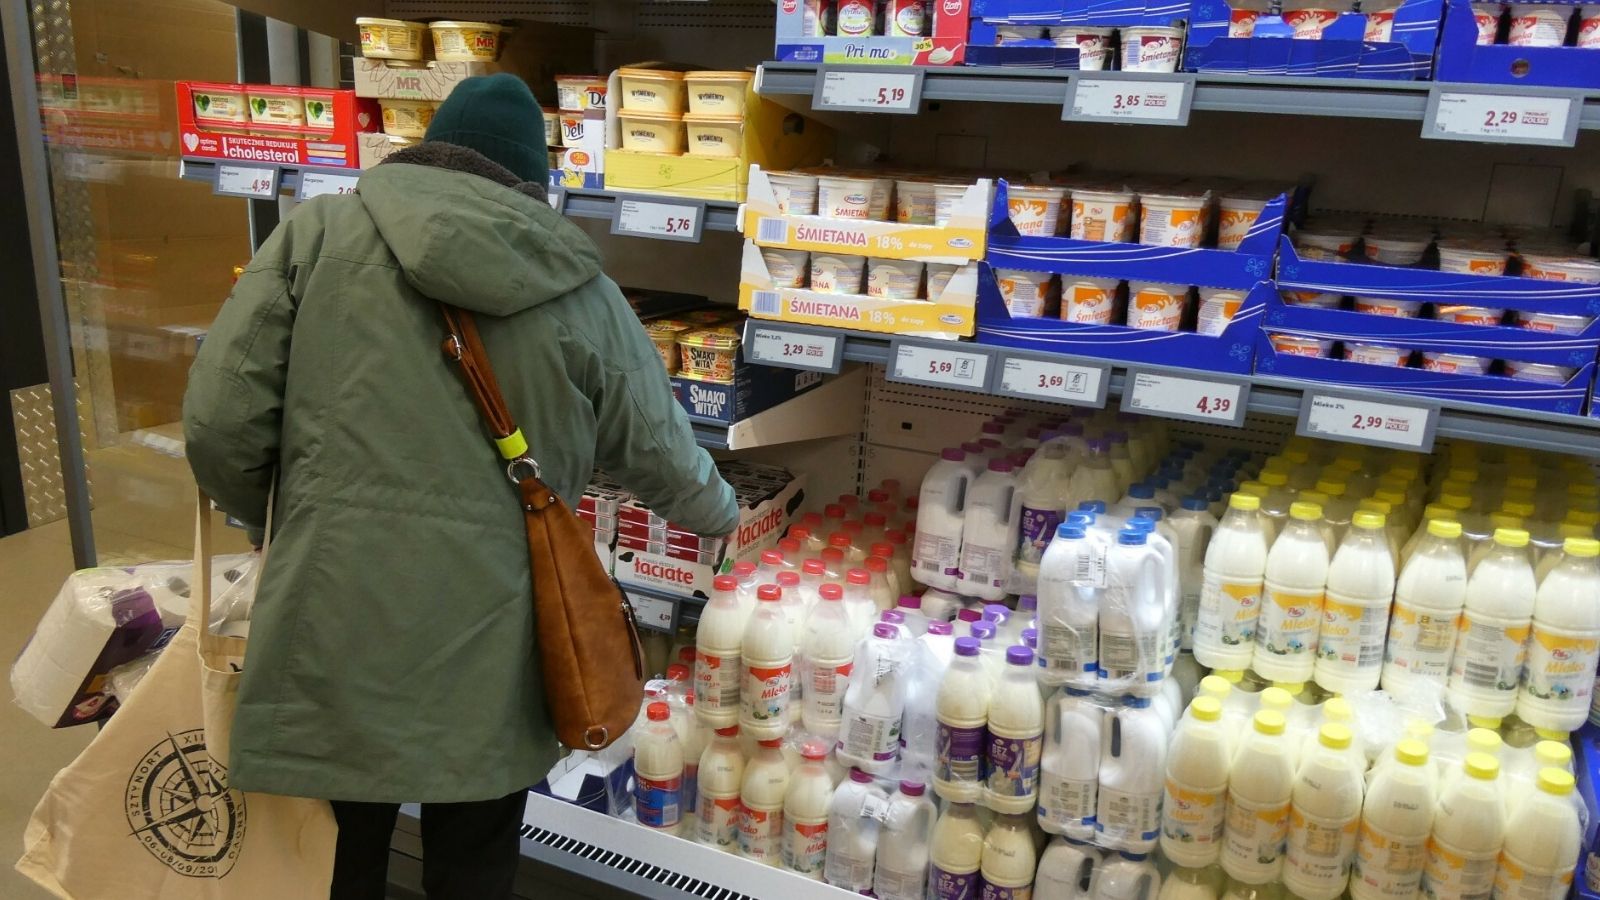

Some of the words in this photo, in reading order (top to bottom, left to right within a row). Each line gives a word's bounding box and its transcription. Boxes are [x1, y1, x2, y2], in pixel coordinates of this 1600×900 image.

[476, 37, 494, 48] MR
[845, 44, 865, 58] Pri
[396, 76, 422, 91] MR
[877, 87, 905, 105] 5.19
[1113, 94, 1140, 109] 3.85
[1484, 110, 1518, 127] 2.29
[229, 137, 265, 146] SKUTECZNIE
[265, 140, 298, 149] REDUKUJE
[231, 146, 299, 163] cholesterol
[666, 217, 691, 233] 5.76
[796, 224, 867, 246] ŚMIETANA
[876, 235, 904, 250] 18%
[790, 297, 860, 320] ŚMIETANA
[868, 310, 896, 325] 18%
[691, 347, 715, 363] SMAKO
[783, 343, 803, 356] 3.29
[695, 360, 711, 369] WITA
[929, 361, 952, 374] 5.69
[1038, 375, 1063, 388] 3.69
[689, 384, 726, 409] SMAKO
[695, 401, 719, 417] WITA
[1196, 396, 1230, 414] 4.39
[1313, 401, 1335, 409] Mleko
[1351, 414, 1383, 430] 2.99
[737, 507, 783, 549] łaciate
[634, 557, 694, 585] łaciate
[128, 750, 162, 817] SZTYNORT
